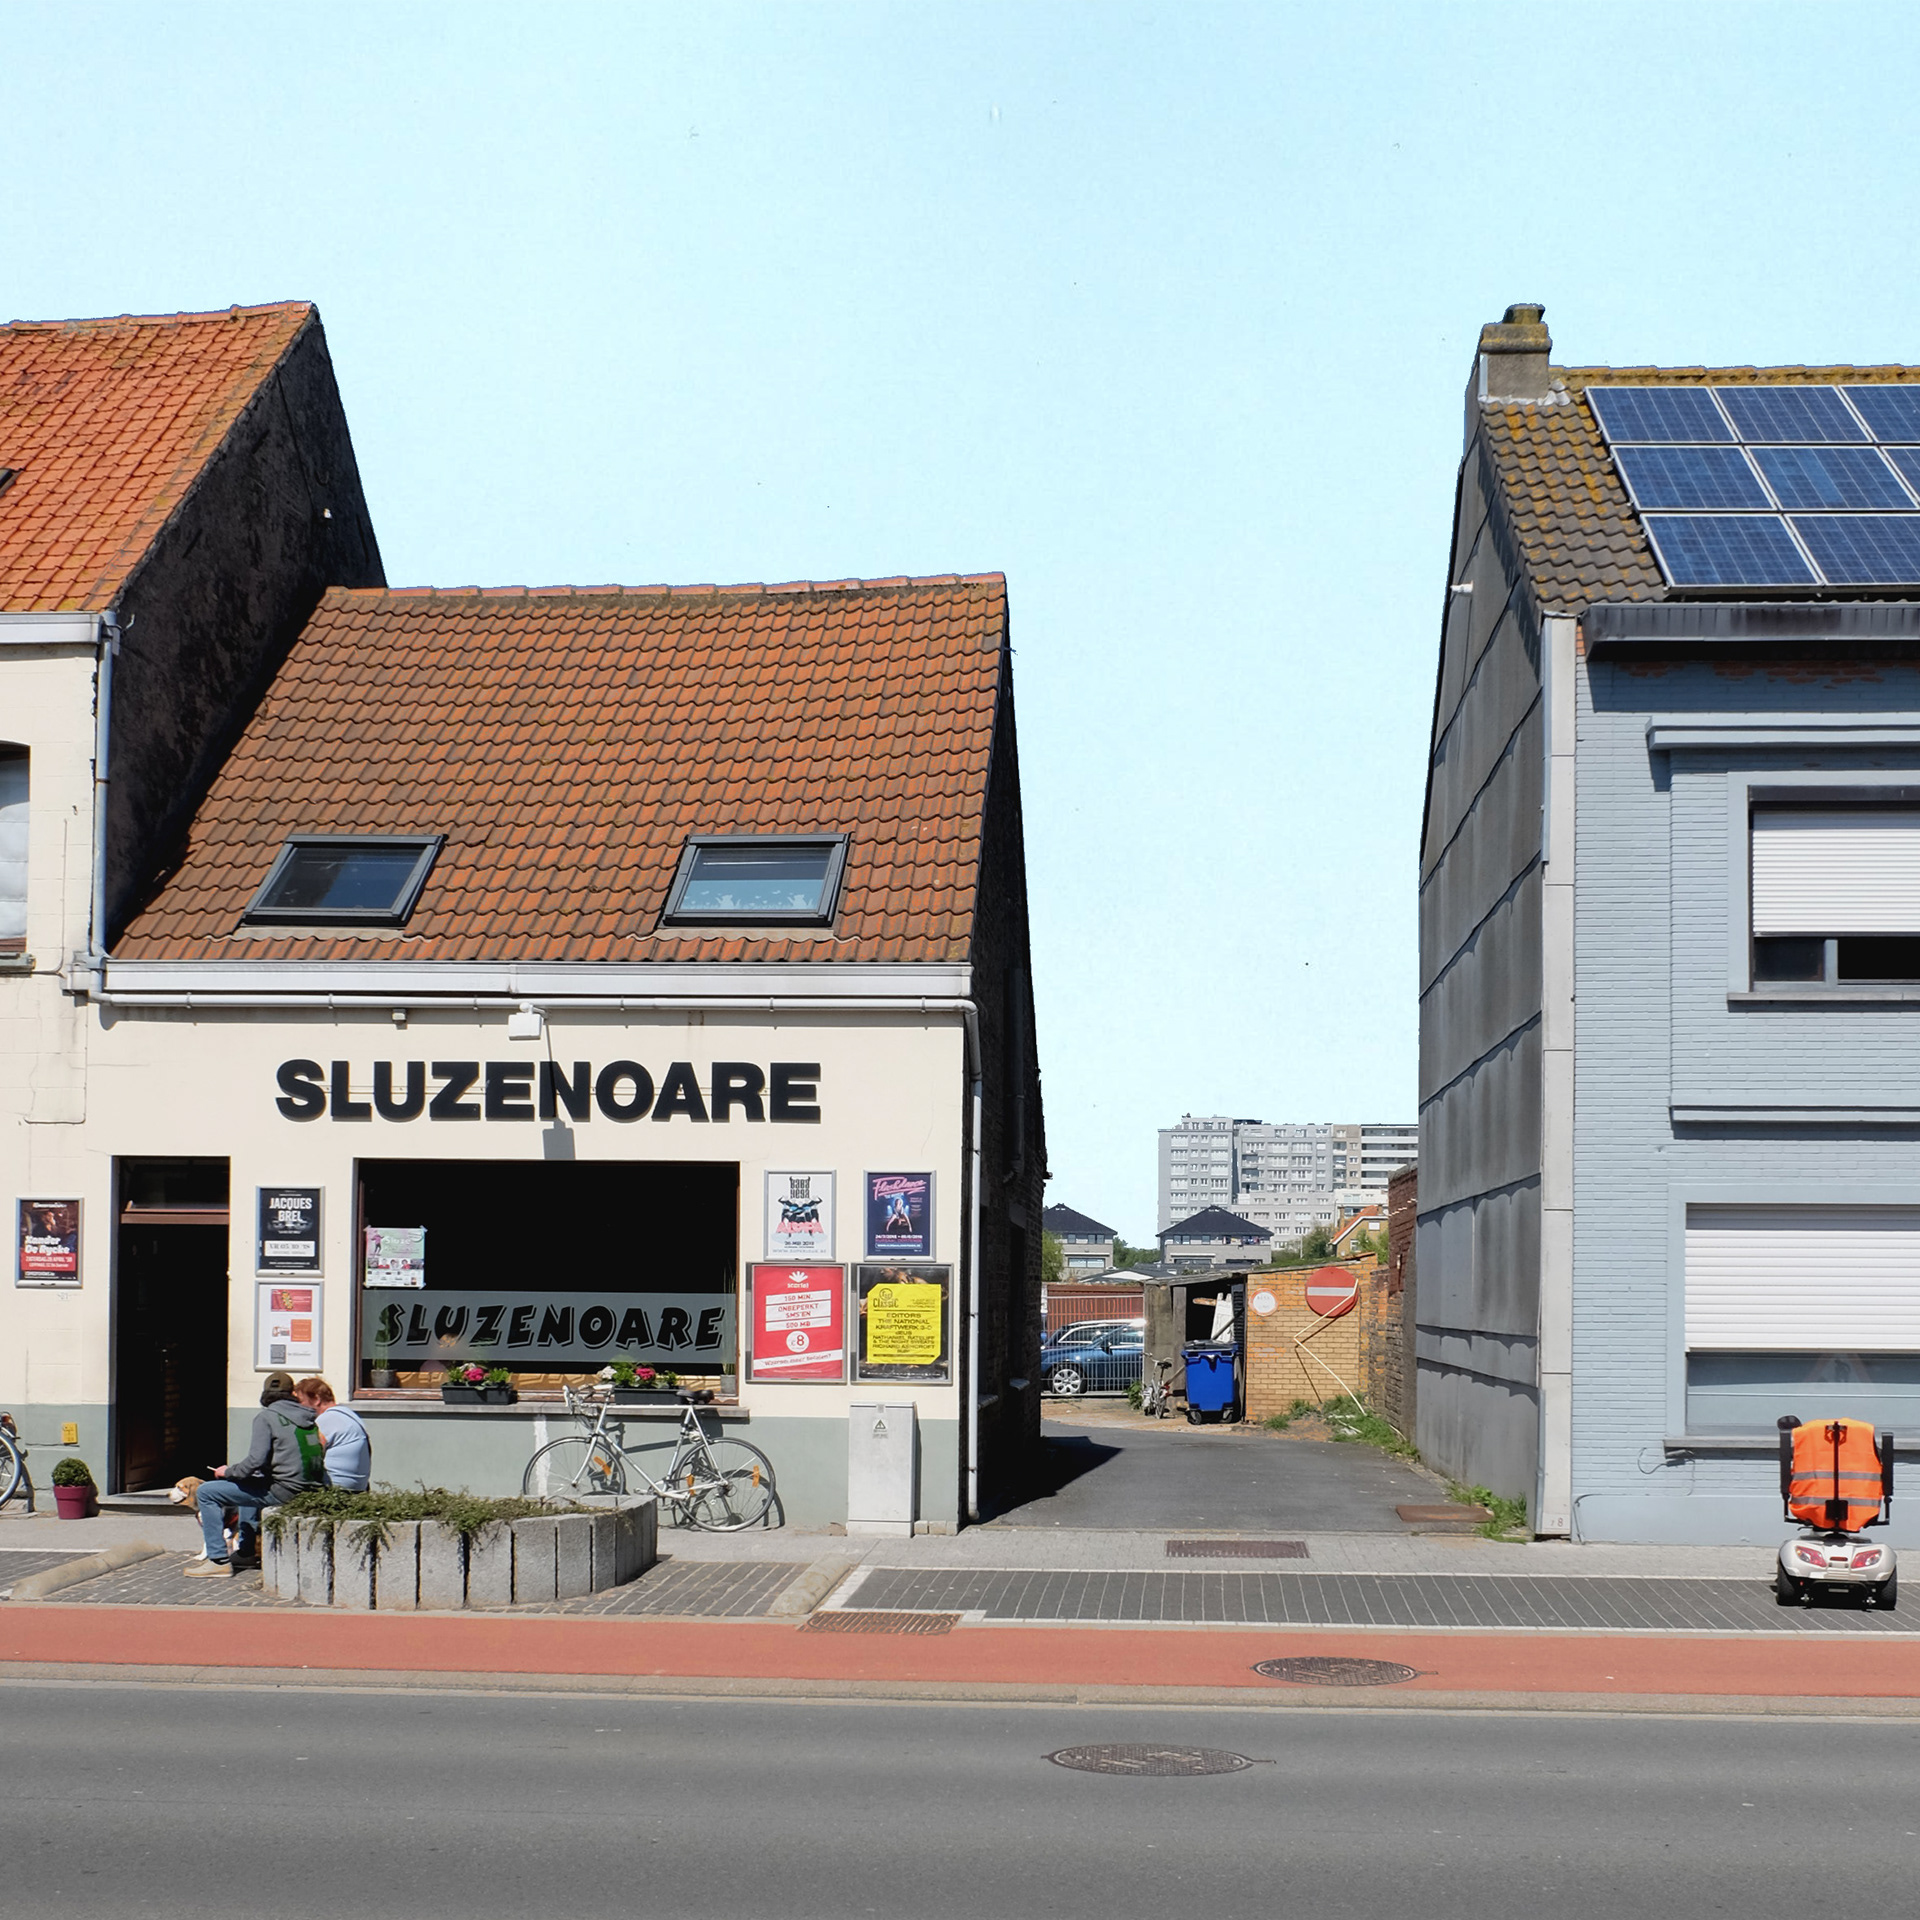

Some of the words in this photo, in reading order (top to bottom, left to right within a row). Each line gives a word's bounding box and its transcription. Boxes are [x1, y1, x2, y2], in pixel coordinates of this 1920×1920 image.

[275, 1059, 822, 1123] SLUZENOARE
[269, 1198, 312, 1210] JACQUES
[278, 1210, 303, 1222] BREL
[778, 1303, 819, 1312] ONBEPERKT
[374, 1303, 725, 1351] SLUZENOARE
